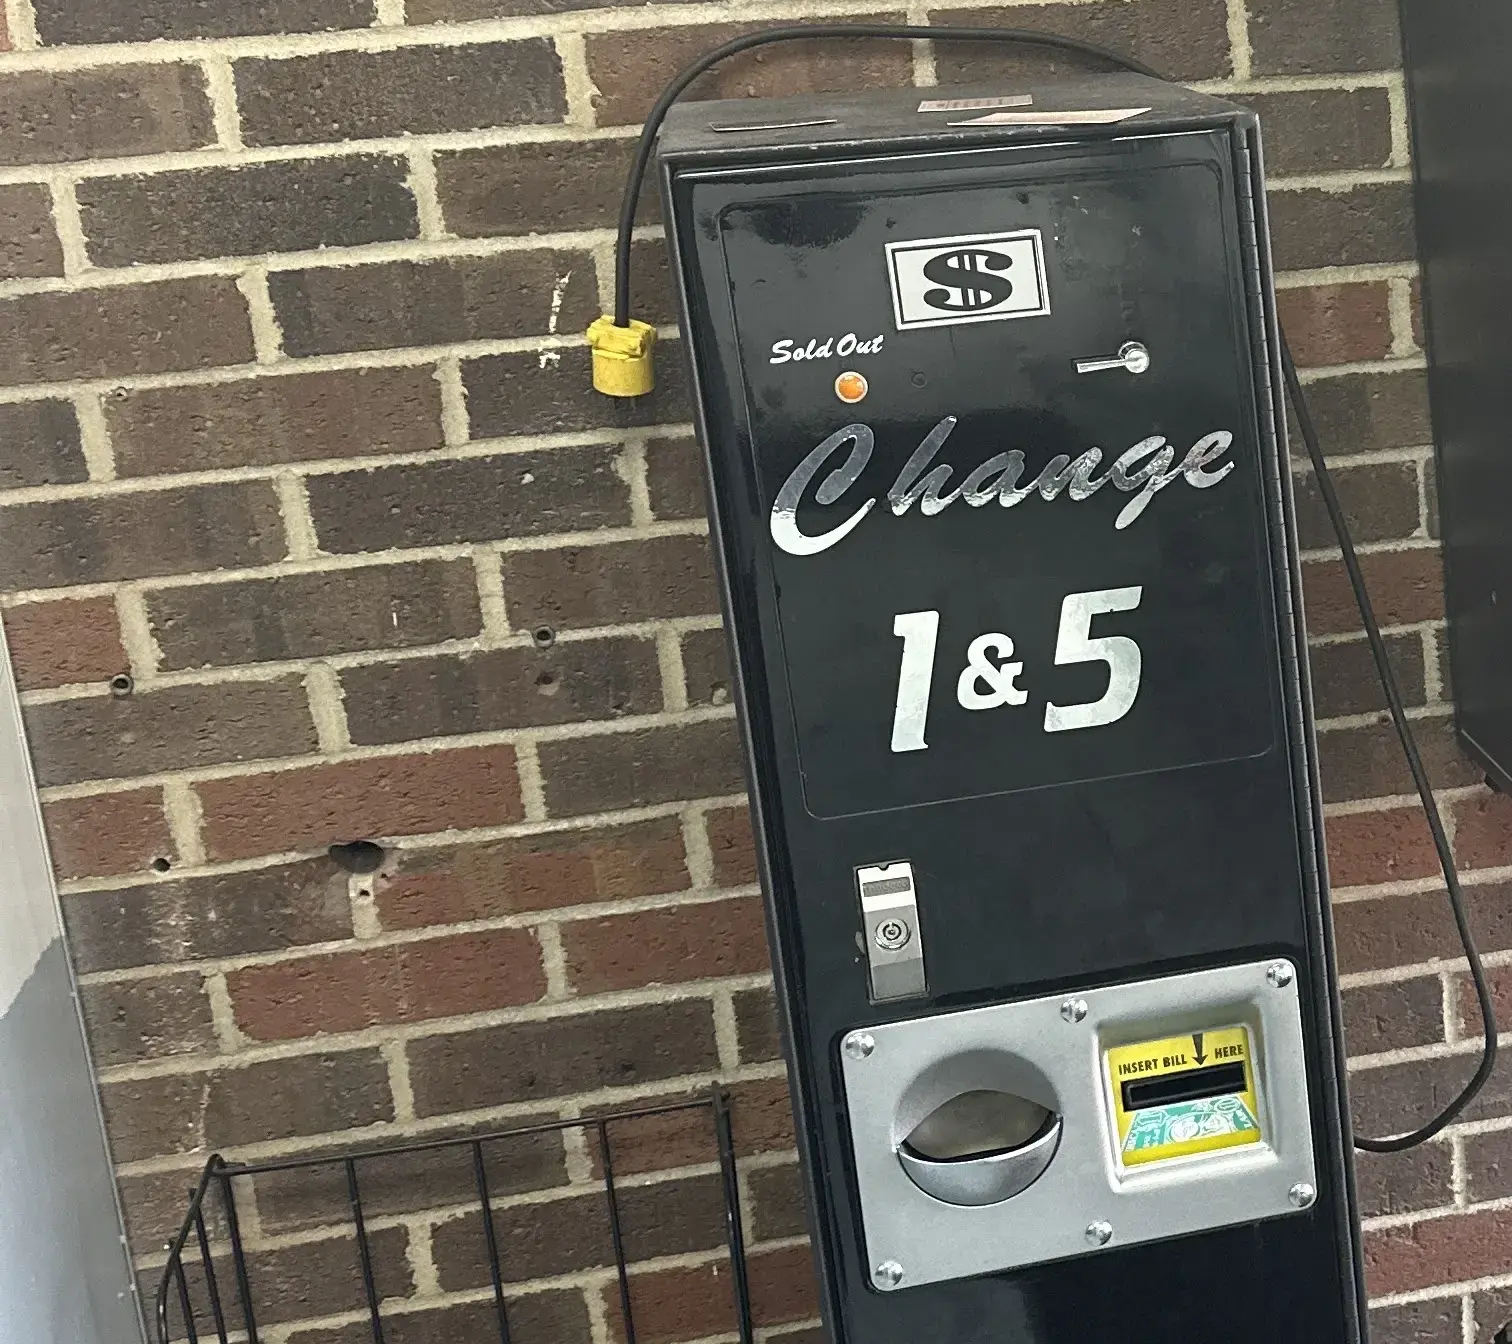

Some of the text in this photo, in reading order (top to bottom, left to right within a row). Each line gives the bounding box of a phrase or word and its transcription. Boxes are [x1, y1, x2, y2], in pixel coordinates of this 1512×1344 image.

[769, 333, 884, 364] Sold Out
[769, 415, 1234, 556] Change
[1118, 1044, 1244, 1075] INSERT BILL HERE
